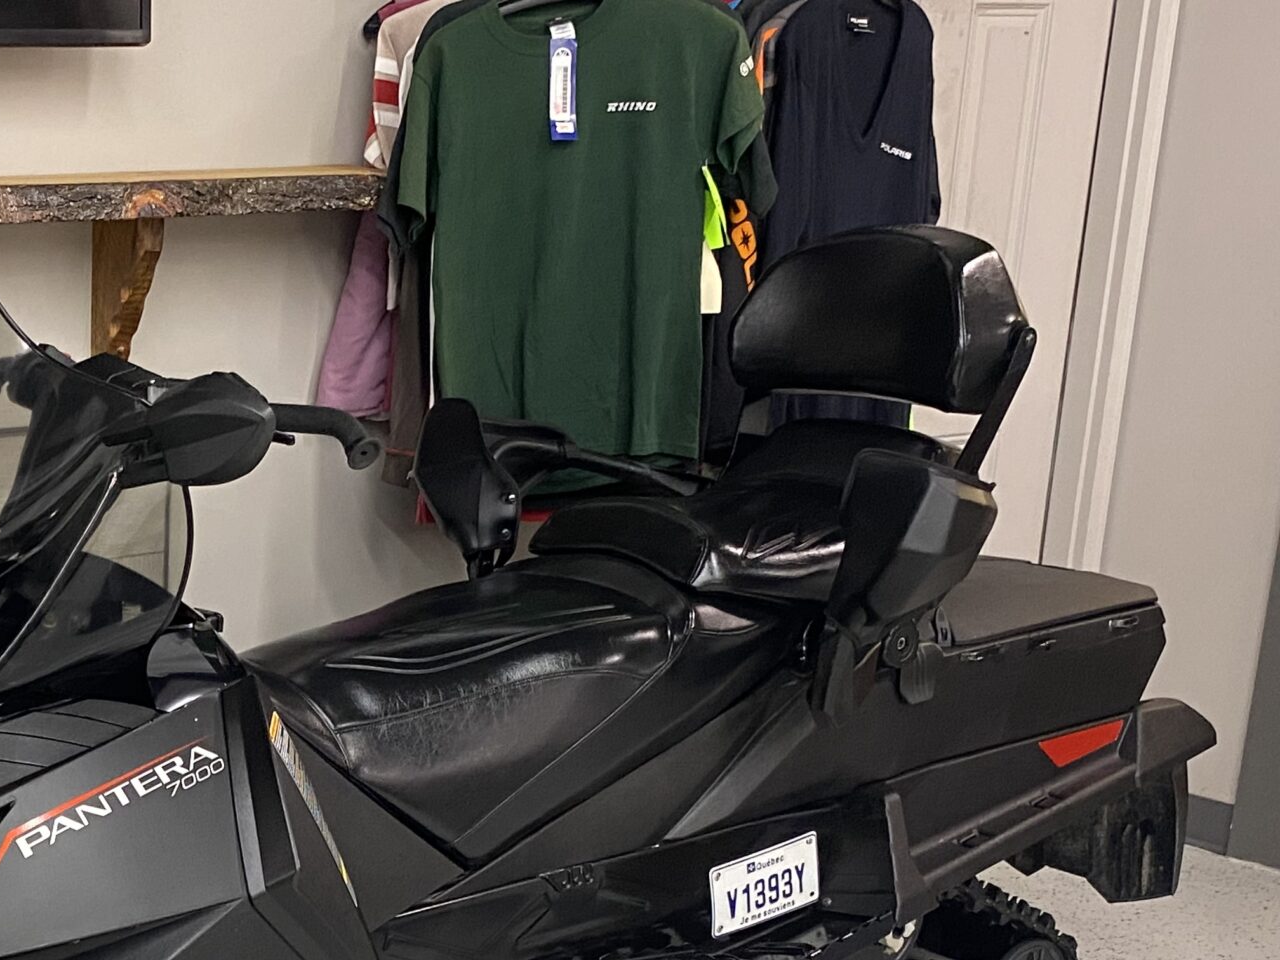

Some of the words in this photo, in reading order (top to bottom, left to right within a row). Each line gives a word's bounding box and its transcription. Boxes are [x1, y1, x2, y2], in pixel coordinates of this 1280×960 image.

[606, 101, 657, 112] RHINO
[880, 142, 912, 160] POLARIS
[730, 198, 757, 293] POL
[165, 757, 225, 798] 7000
[15, 744, 220, 859] PANTERA
[756, 855, 785, 871] Québec
[726, 862, 805, 919] V1393Y
[740, 916, 749, 925] Je
[751, 912, 762, 921] me
[763, 900, 796, 917] souviens
